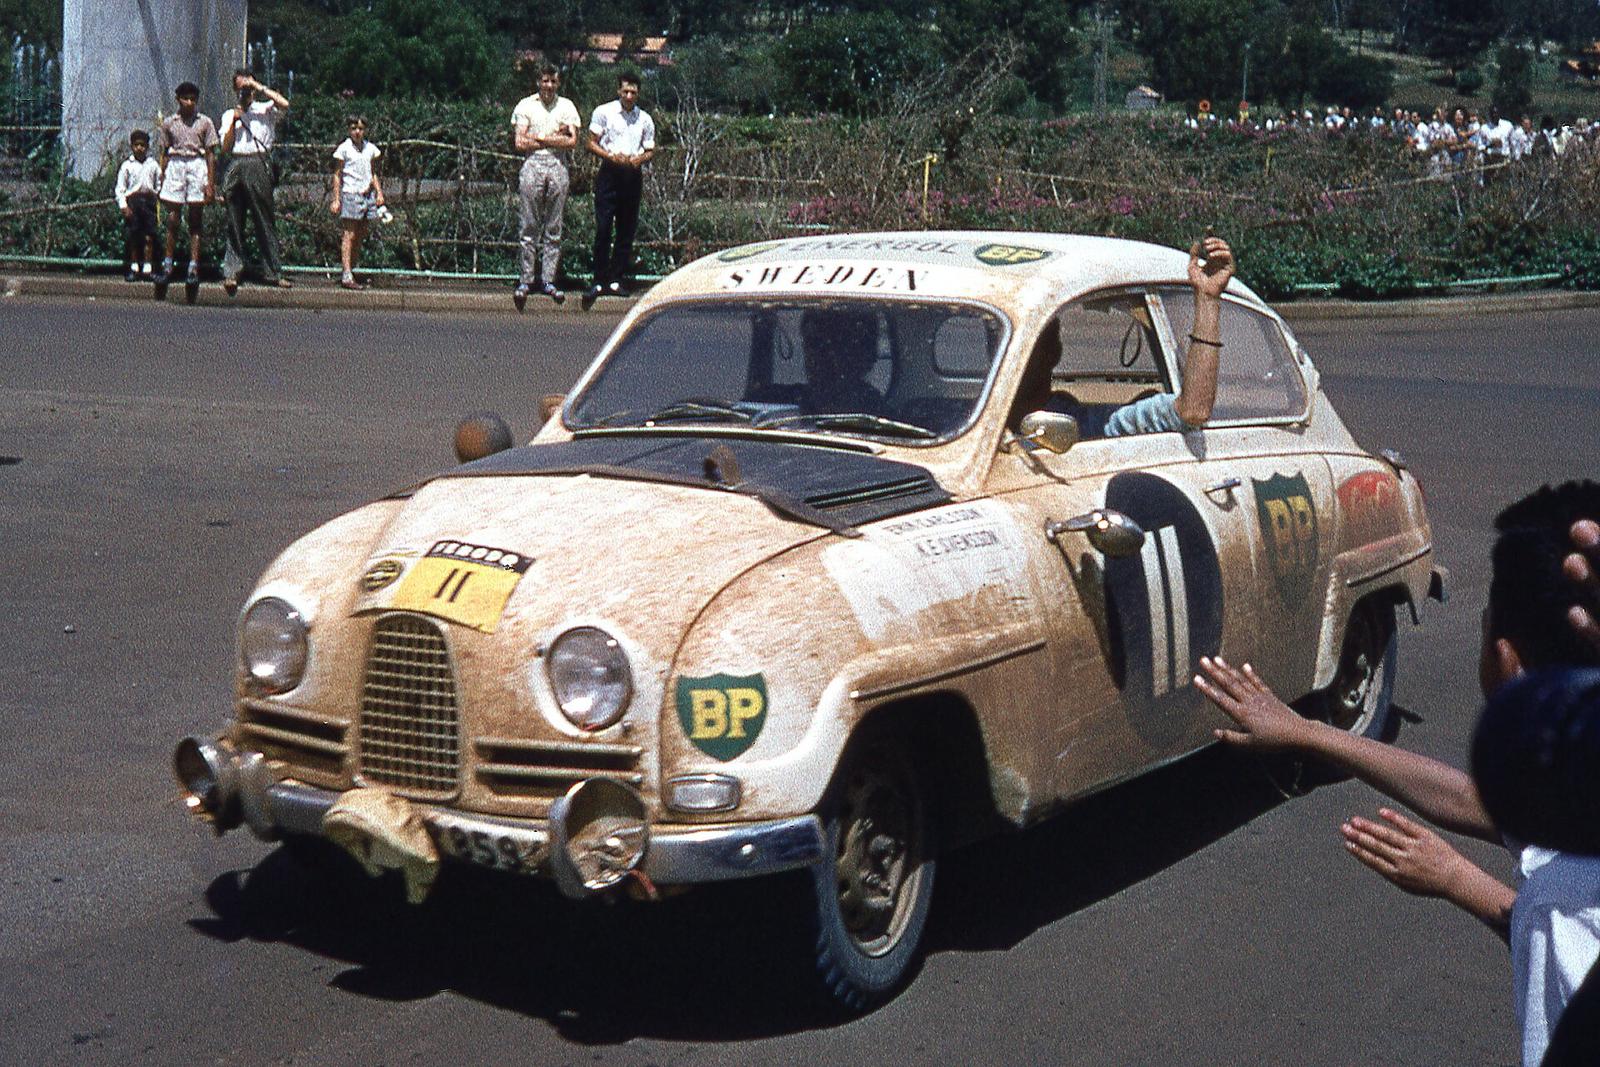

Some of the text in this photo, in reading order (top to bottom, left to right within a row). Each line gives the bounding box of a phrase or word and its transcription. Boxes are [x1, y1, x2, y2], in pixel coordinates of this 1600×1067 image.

[722, 264, 928, 291] SWEDEN
[1264, 495, 1315, 575] BP
[434, 567, 473, 603] 11
[1139, 525, 1191, 697] 11
[688, 687, 763, 739] BP
